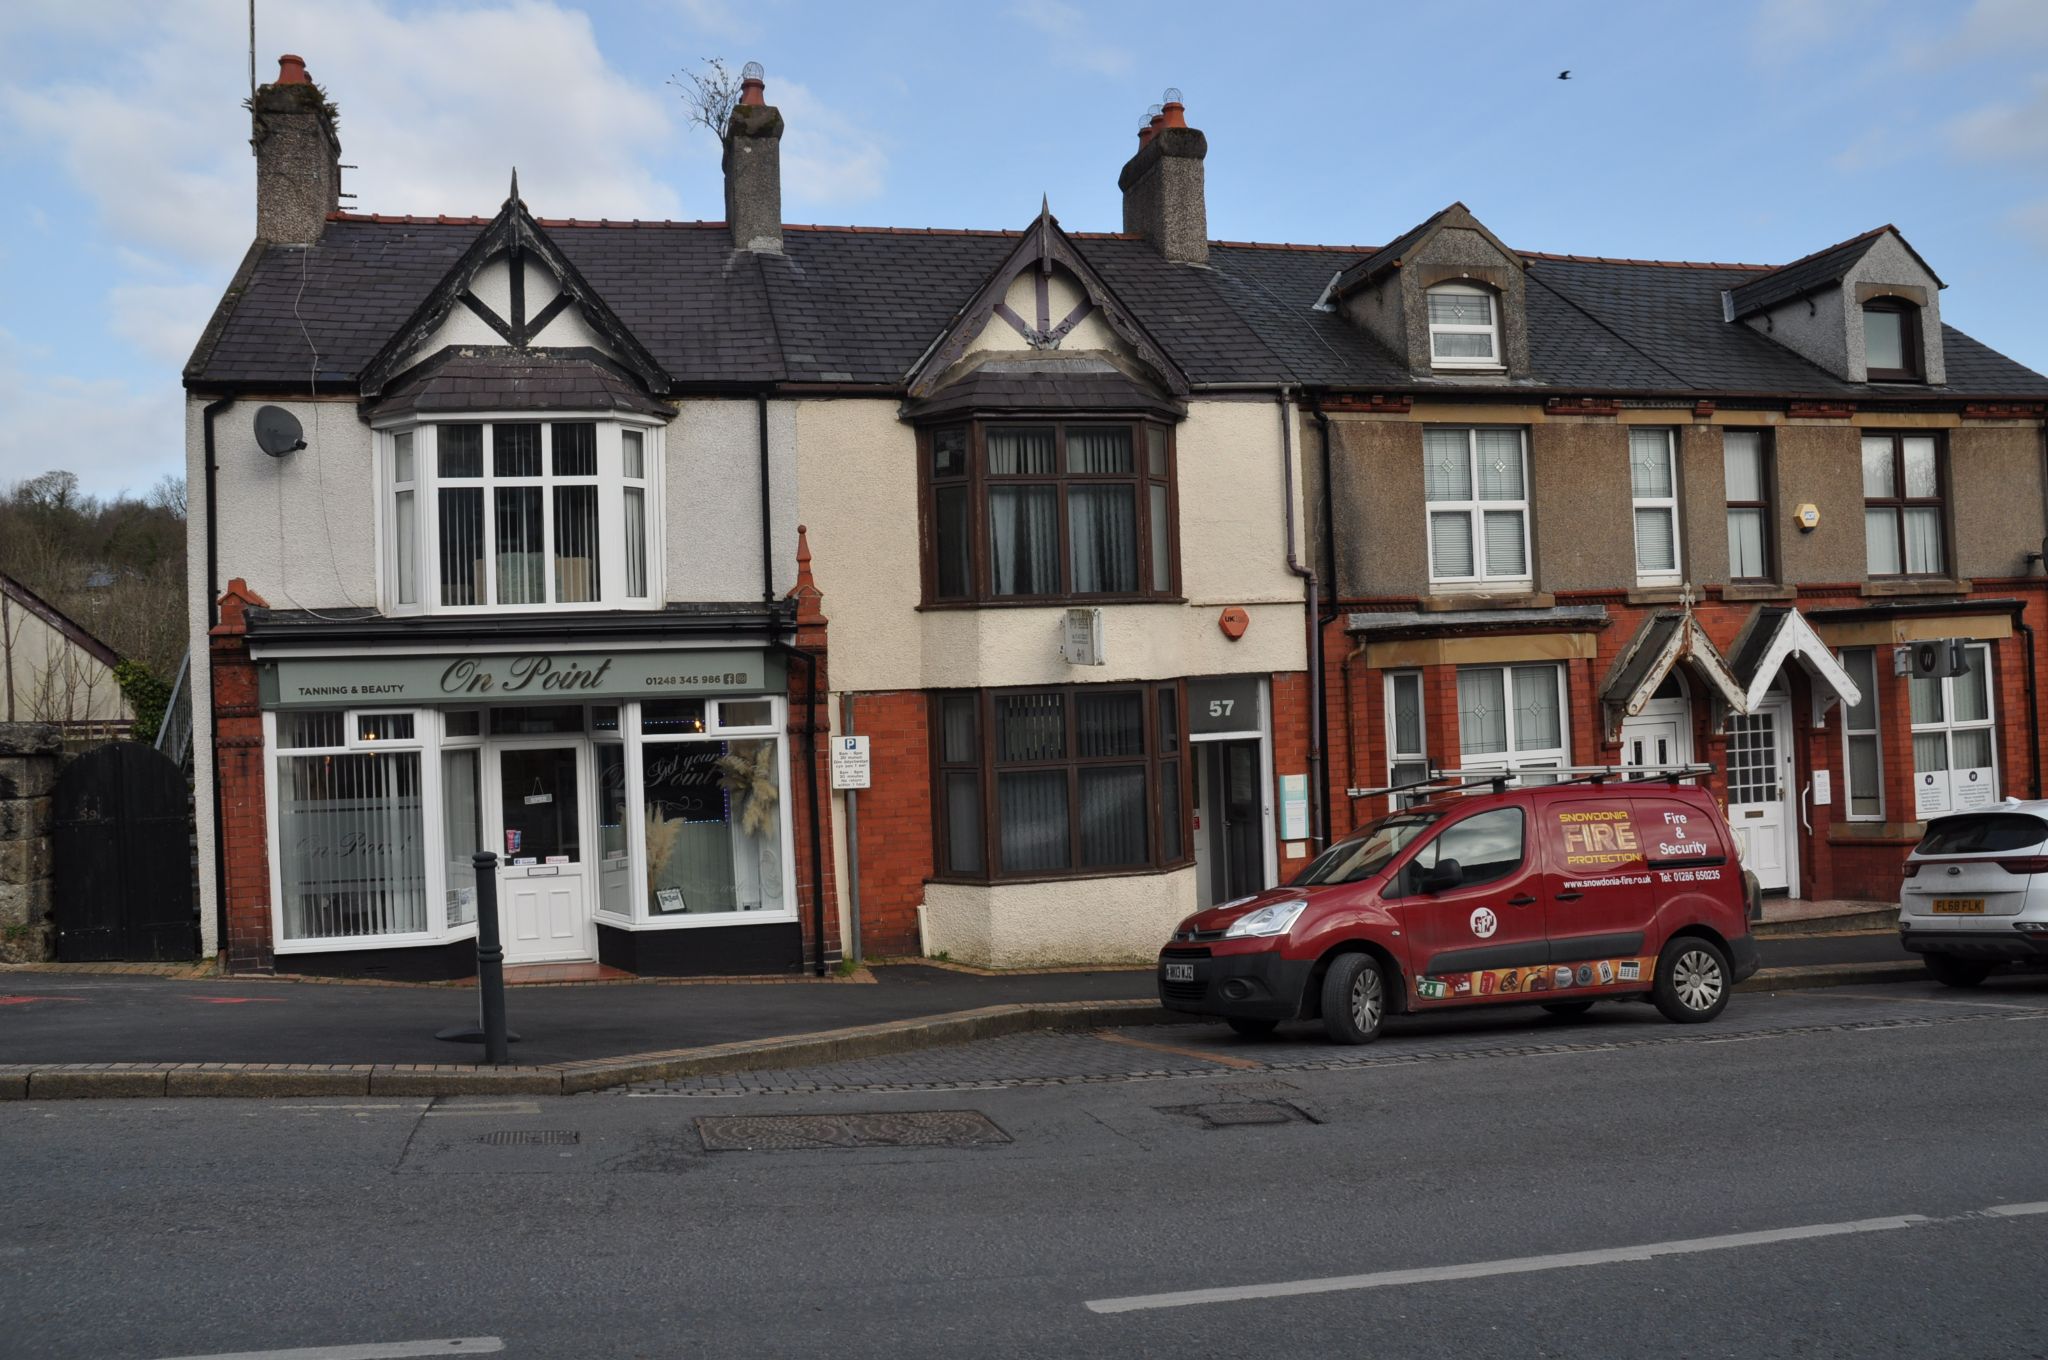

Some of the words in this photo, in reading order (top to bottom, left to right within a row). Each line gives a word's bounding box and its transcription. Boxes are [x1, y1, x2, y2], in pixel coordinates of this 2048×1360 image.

[440, 657, 495, 693] On
[502, 656, 612, 691] Point
[645, 676, 676, 685] 01248
[679, 675, 698, 684] 345
[702, 675, 720, 684] 986
[298, 686, 348, 695] TANNING
[351, 686, 358, 694] &
[361, 684, 405, 694] BEAUTY
[1209, 700, 1234, 717] 57
[1559, 811, 1629, 822] SNOWDONIA
[1664, 812, 1688, 825] Fire
[1562, 822, 1638, 853] FIRE
[1675, 827, 1686, 839] &
[1659, 841, 1707, 856] Security
[1567, 853, 1642, 864] PROTECTION
